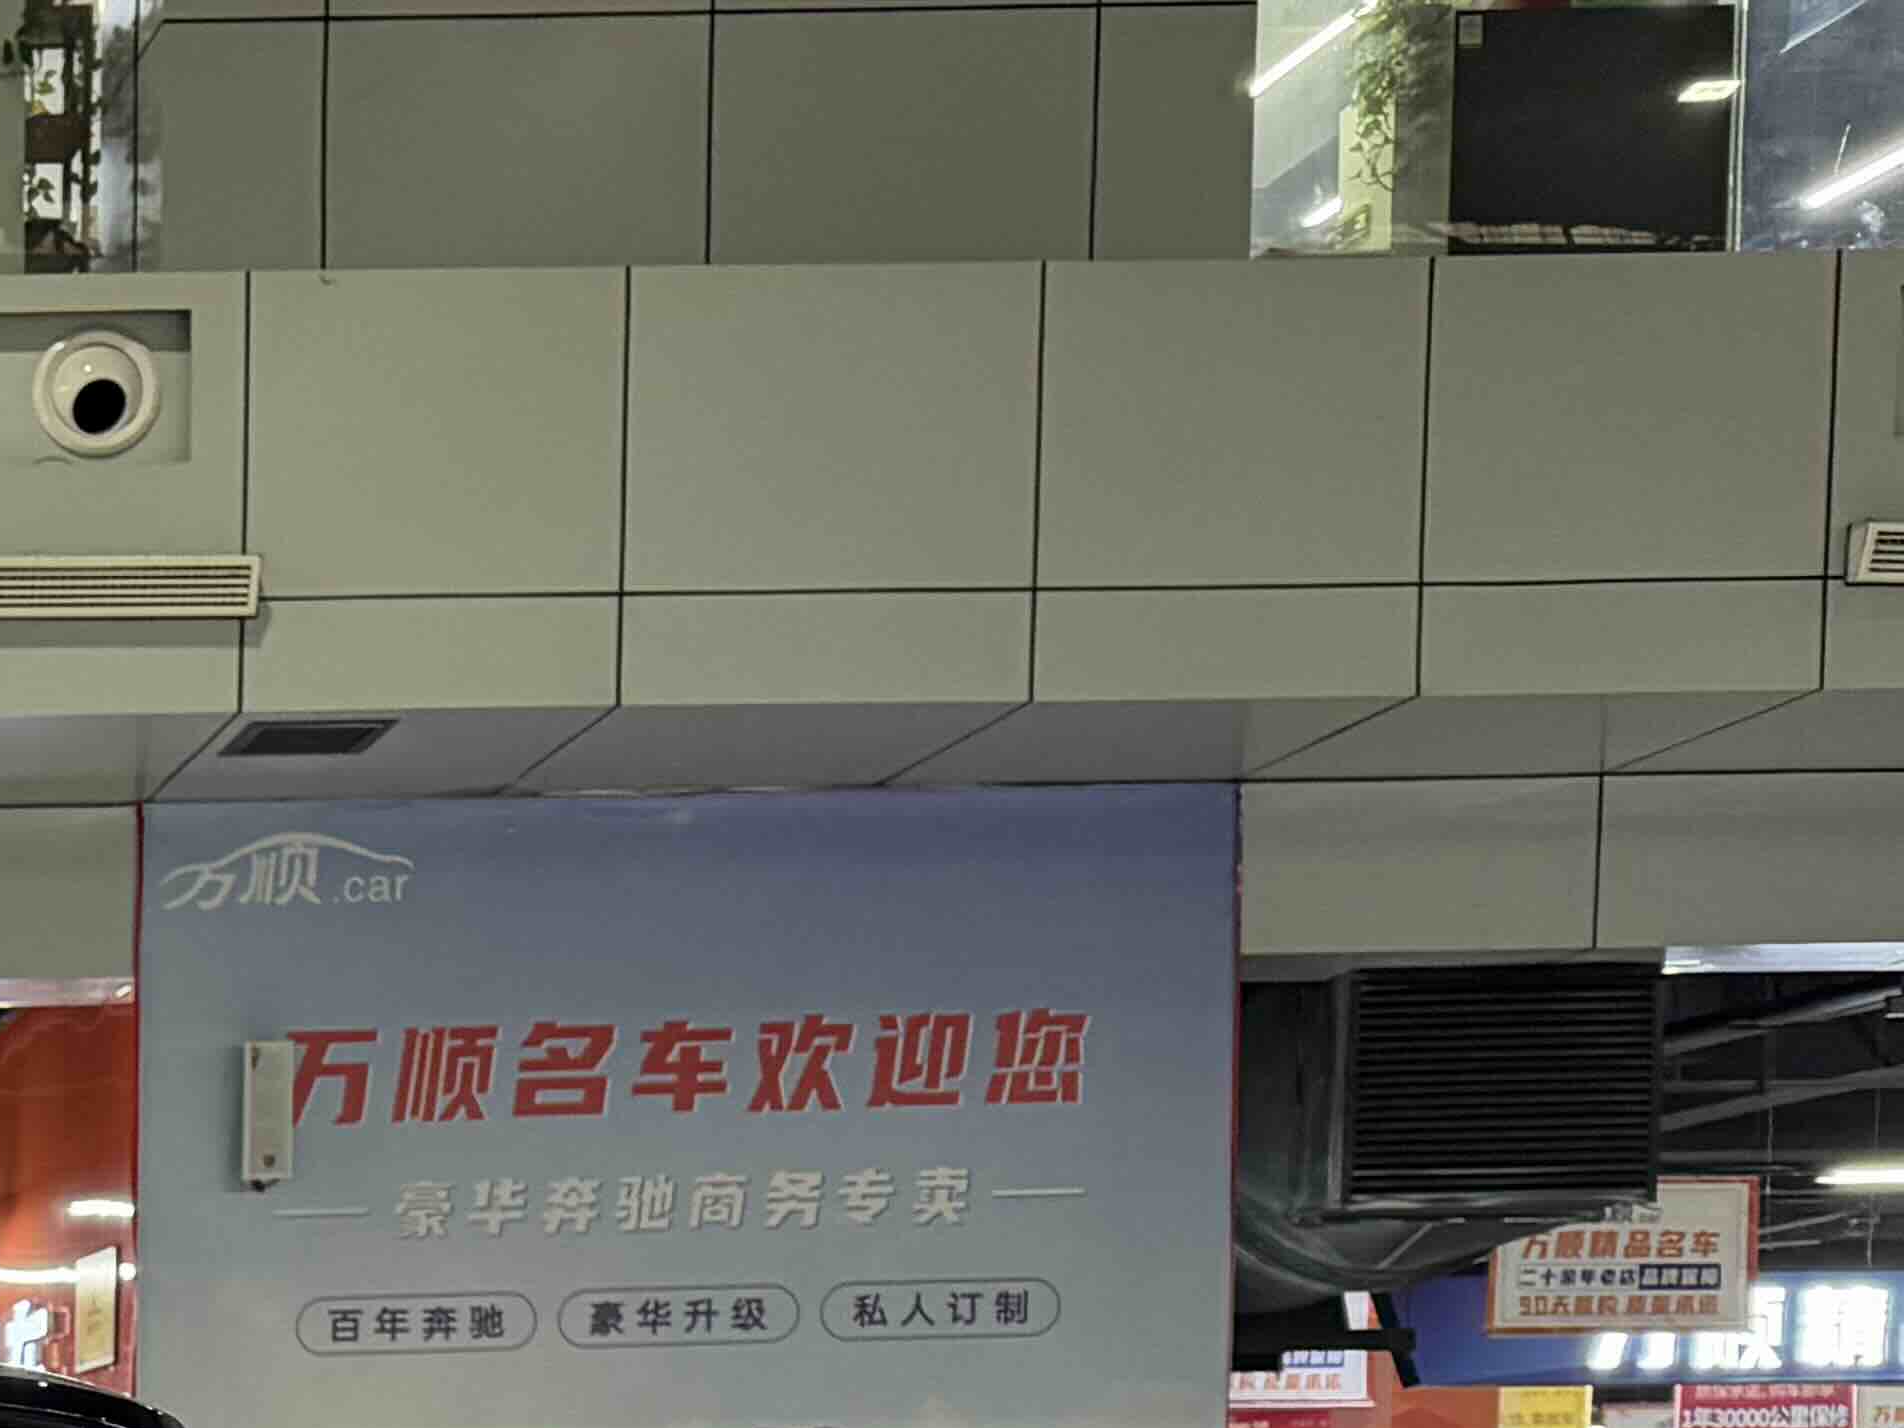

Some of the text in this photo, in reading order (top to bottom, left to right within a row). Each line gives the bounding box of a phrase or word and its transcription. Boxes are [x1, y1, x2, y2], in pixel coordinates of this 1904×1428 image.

[159, 836, 322, 911] 万顺
[286, 1007, 1088, 1127] 万顺名车欢迎您
[393, 1166, 971, 1239] 豪华奔驰商务专卖
[325, 1302, 508, 1345] 百年奔驰
[587, 1294, 769, 1338] 豪华升级
[850, 1288, 1032, 1330] 私人订制
